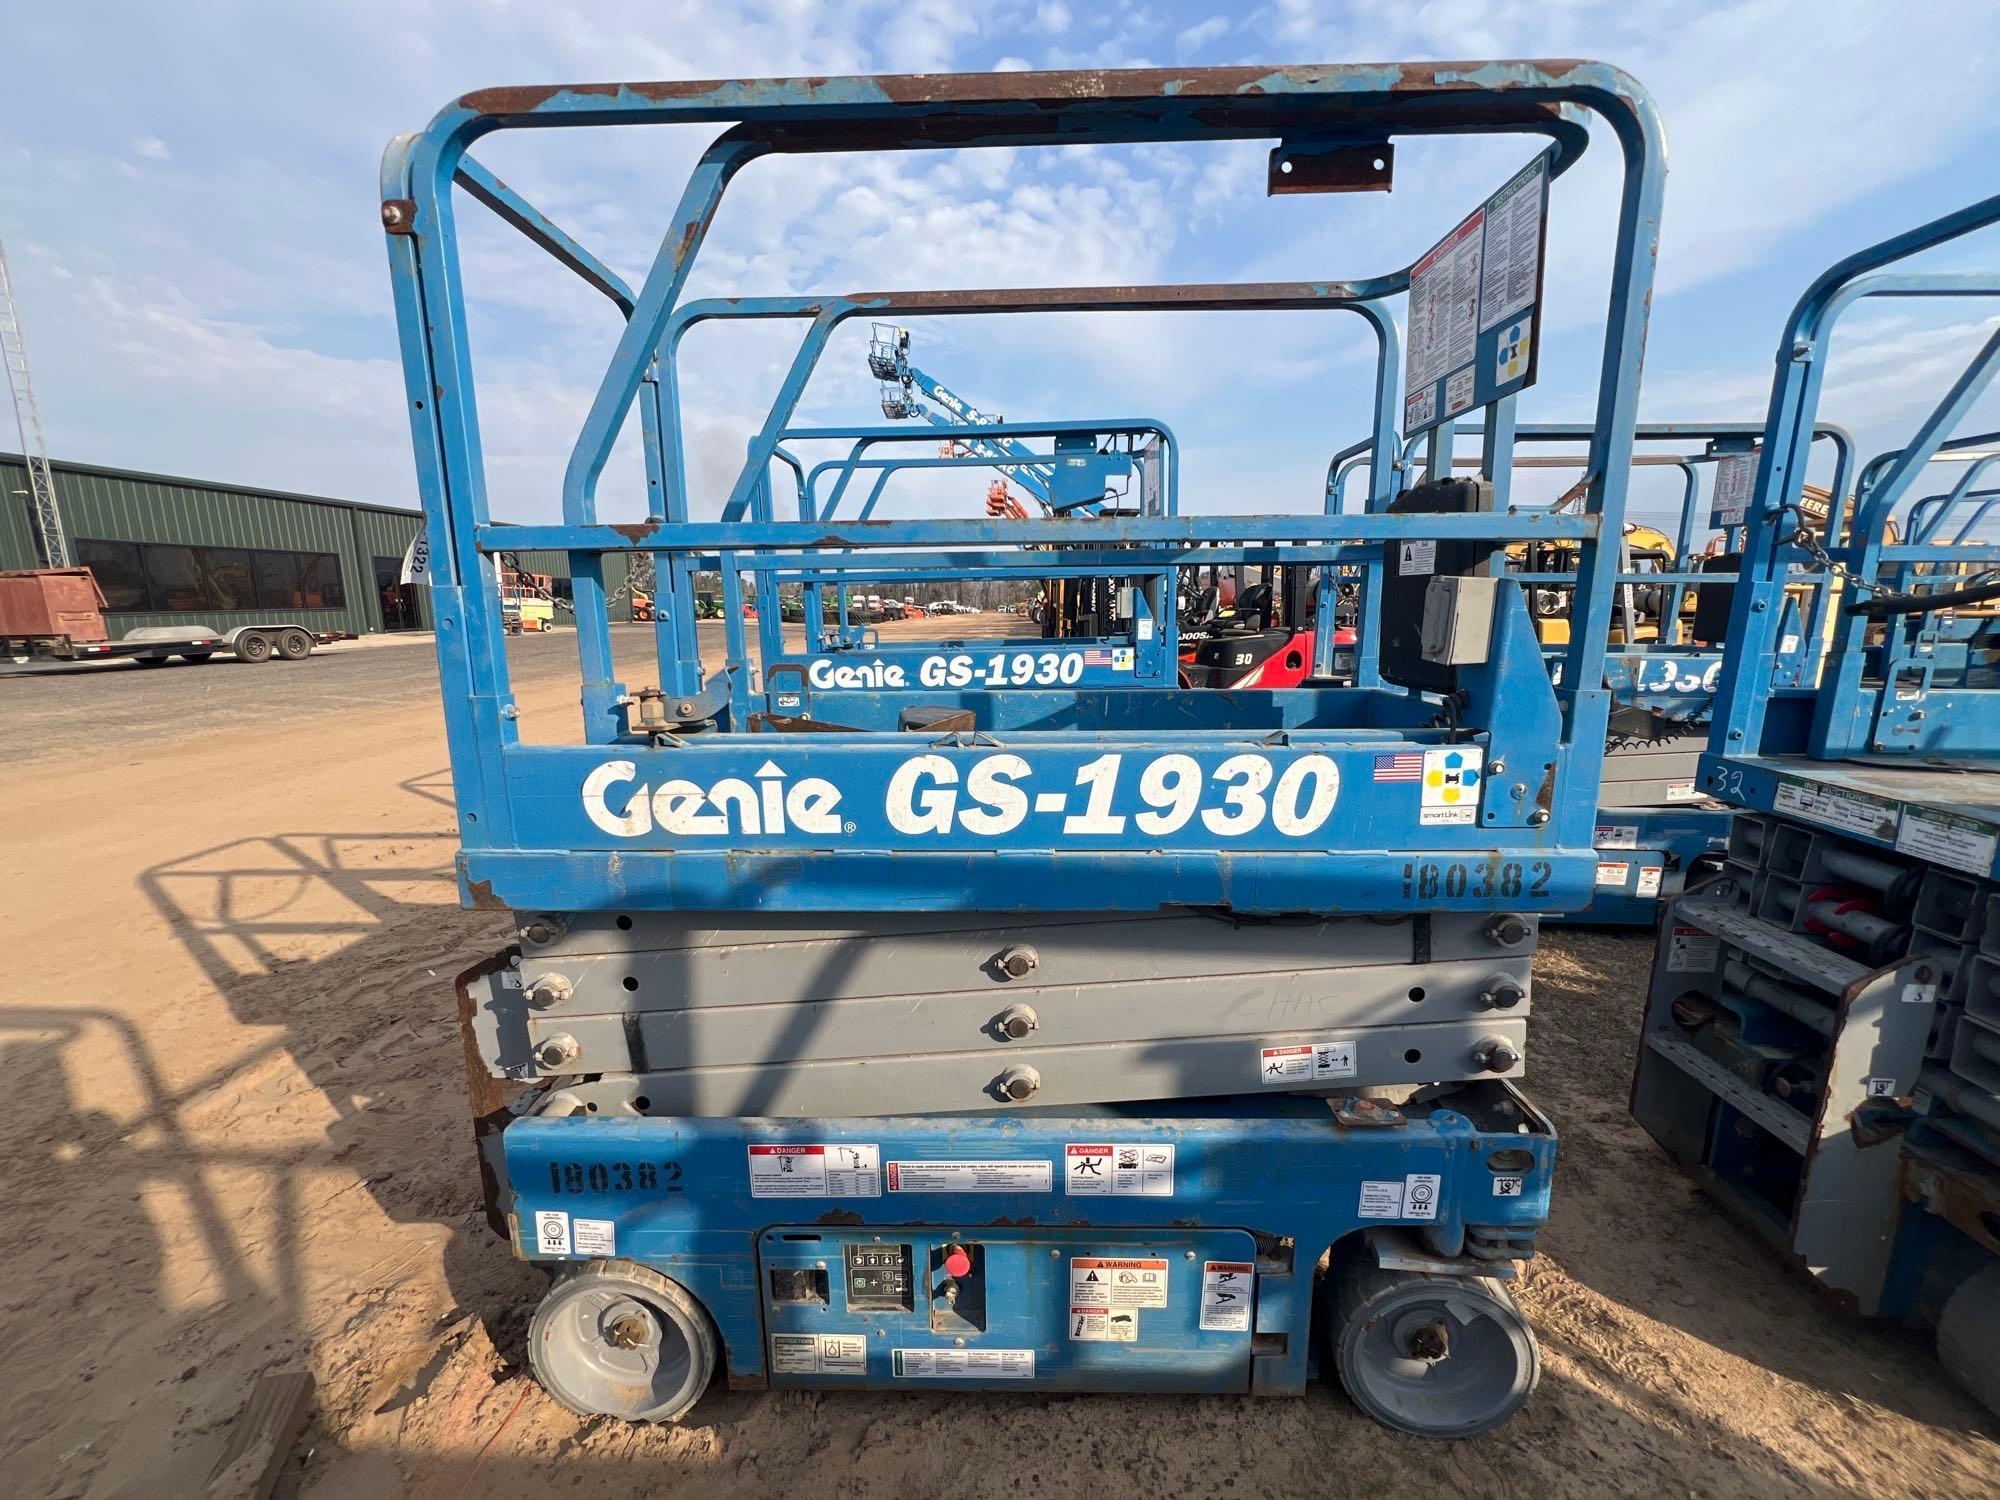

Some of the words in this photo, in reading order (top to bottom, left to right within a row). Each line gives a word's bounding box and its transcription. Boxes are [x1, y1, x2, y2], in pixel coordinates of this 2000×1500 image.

[1800, 497, 1830, 515] EERE
[808, 658, 905, 689] Genie
[920, 652, 1084, 687] GS-1930
[1235, 653, 1253, 666] 30
[581, 754, 843, 837] Genie
[886, 753, 1340, 837] GS-1930
[1717, 766, 1746, 802] 32
[1403, 861, 1552, 899] 180382
[550, 1161, 684, 1195] 180382
[1105, 1261, 1142, 1269] WARNING
[1217, 1264, 1248, 1272] WARNING
